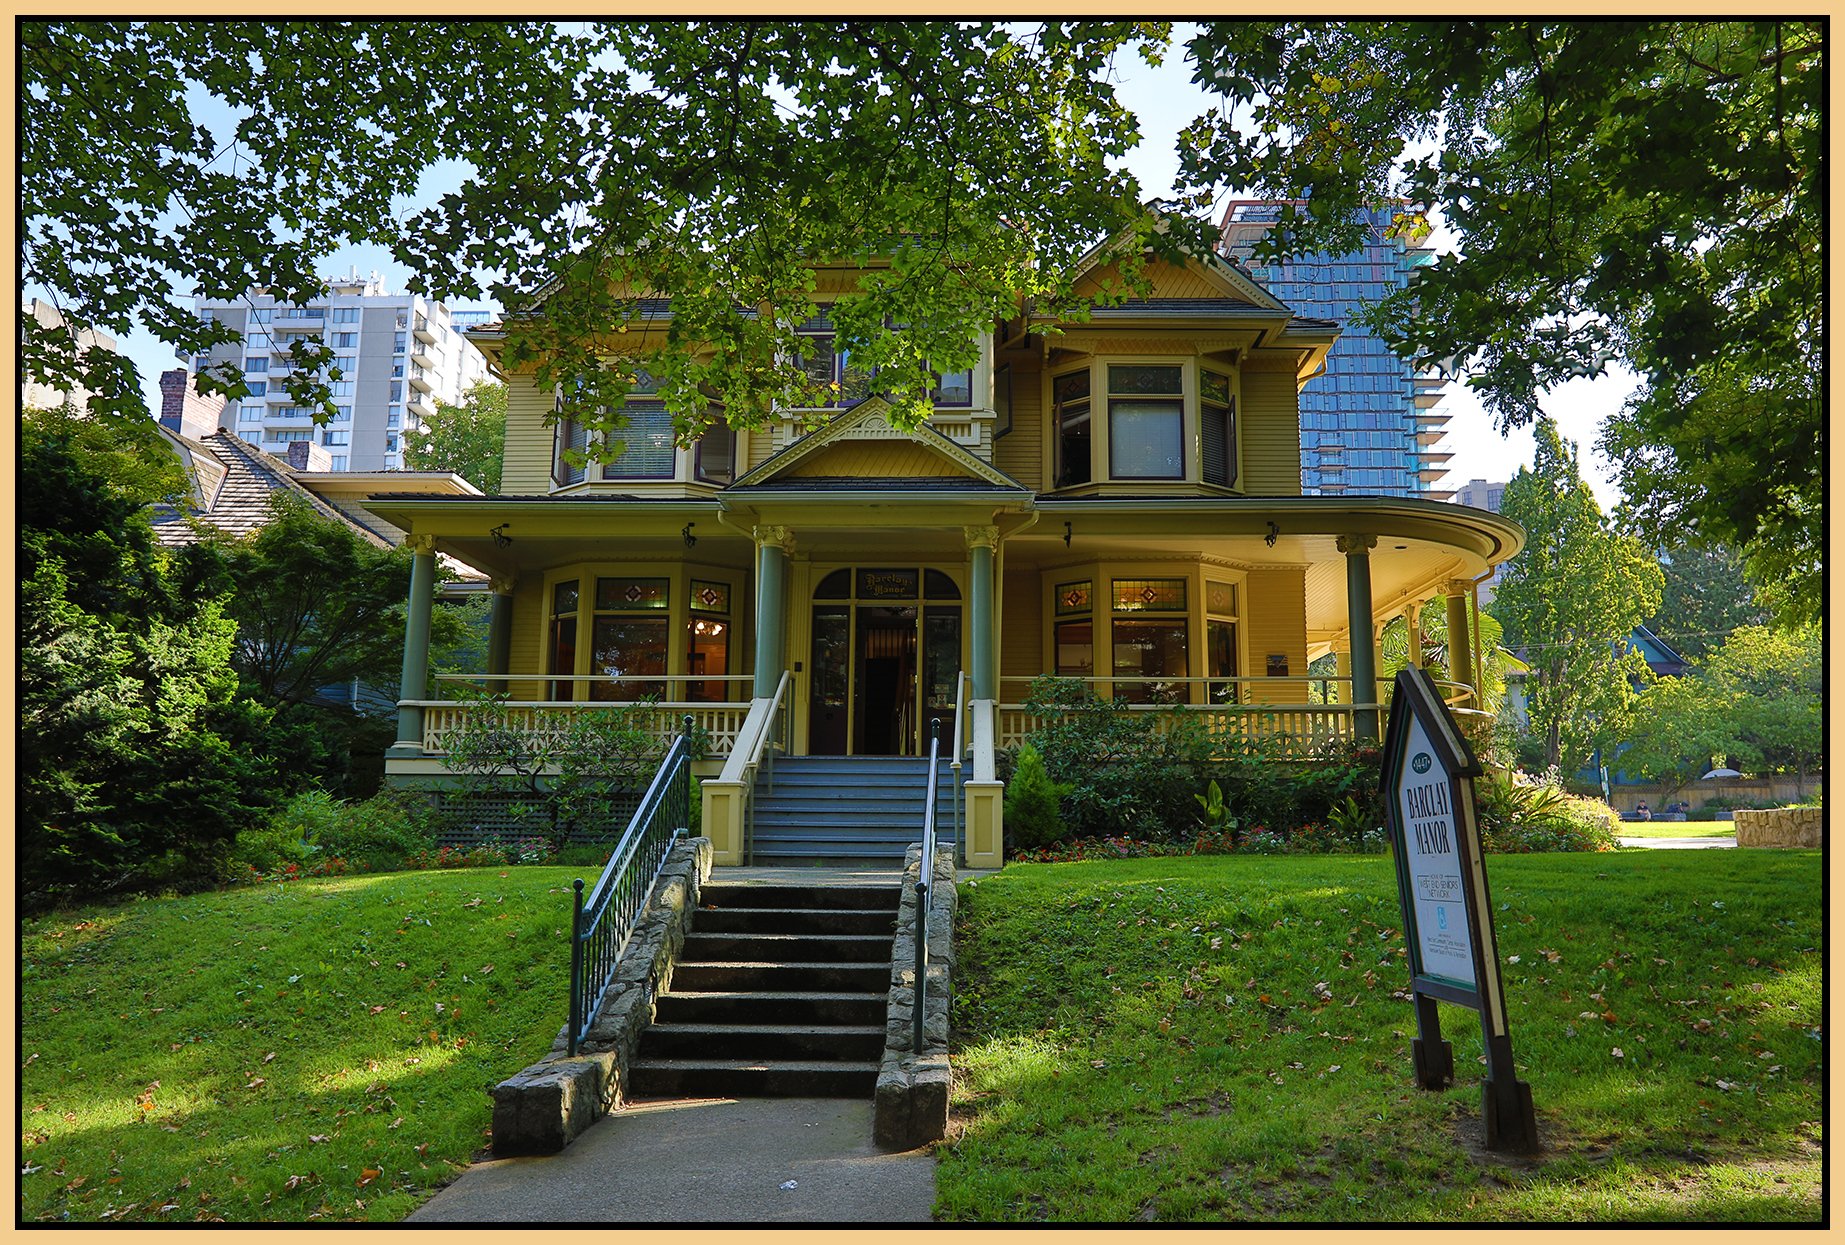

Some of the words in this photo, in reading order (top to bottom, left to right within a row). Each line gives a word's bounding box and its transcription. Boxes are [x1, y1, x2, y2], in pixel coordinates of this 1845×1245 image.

[1414, 756, 1429, 770] 1447
[1407, 781, 1450, 819] BARCLAY
[1415, 820, 1451, 855] MANOR
